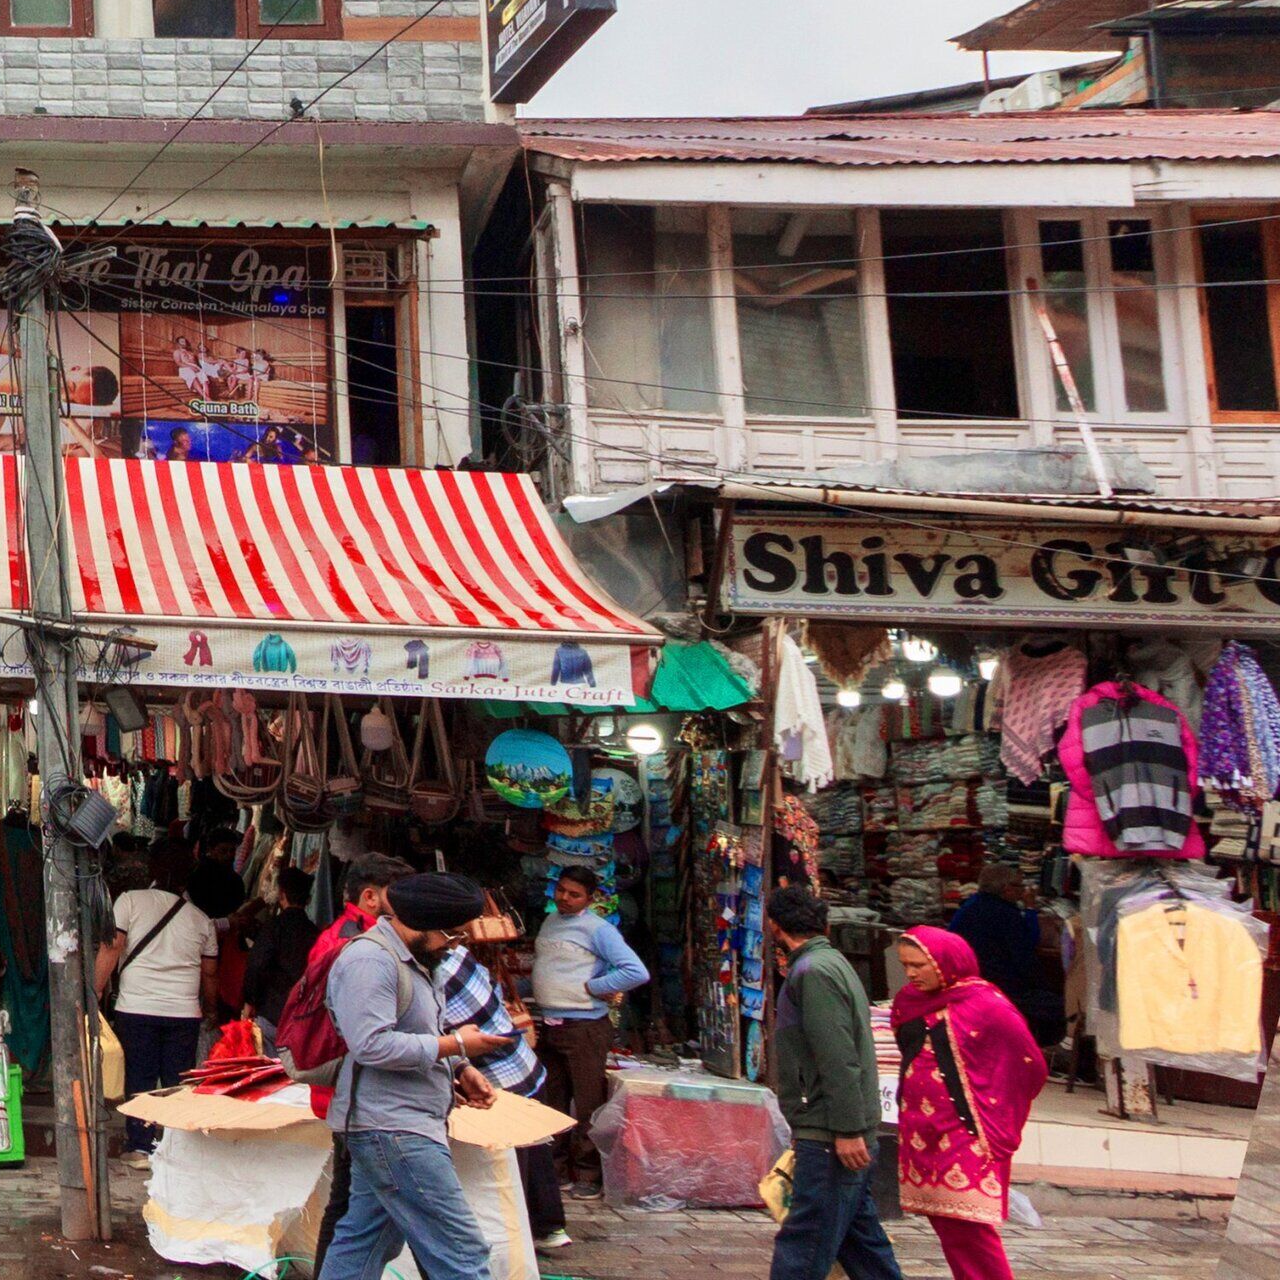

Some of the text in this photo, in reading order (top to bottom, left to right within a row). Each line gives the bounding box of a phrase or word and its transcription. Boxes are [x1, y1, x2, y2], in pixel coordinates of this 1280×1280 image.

[126, 246, 211, 290] Thai
[230, 248, 312, 302] Spa
[122, 297, 326, 317] Sister Concern Himalaya Spa
[191, 401, 259, 416] Sauna Bath
[742, 531, 1006, 601] Shiva
[158, 672, 190, 683] সকল
[193, 673, 228, 685] প্রকার
[429, 681, 625, 704] Sarkar Jute Craft
